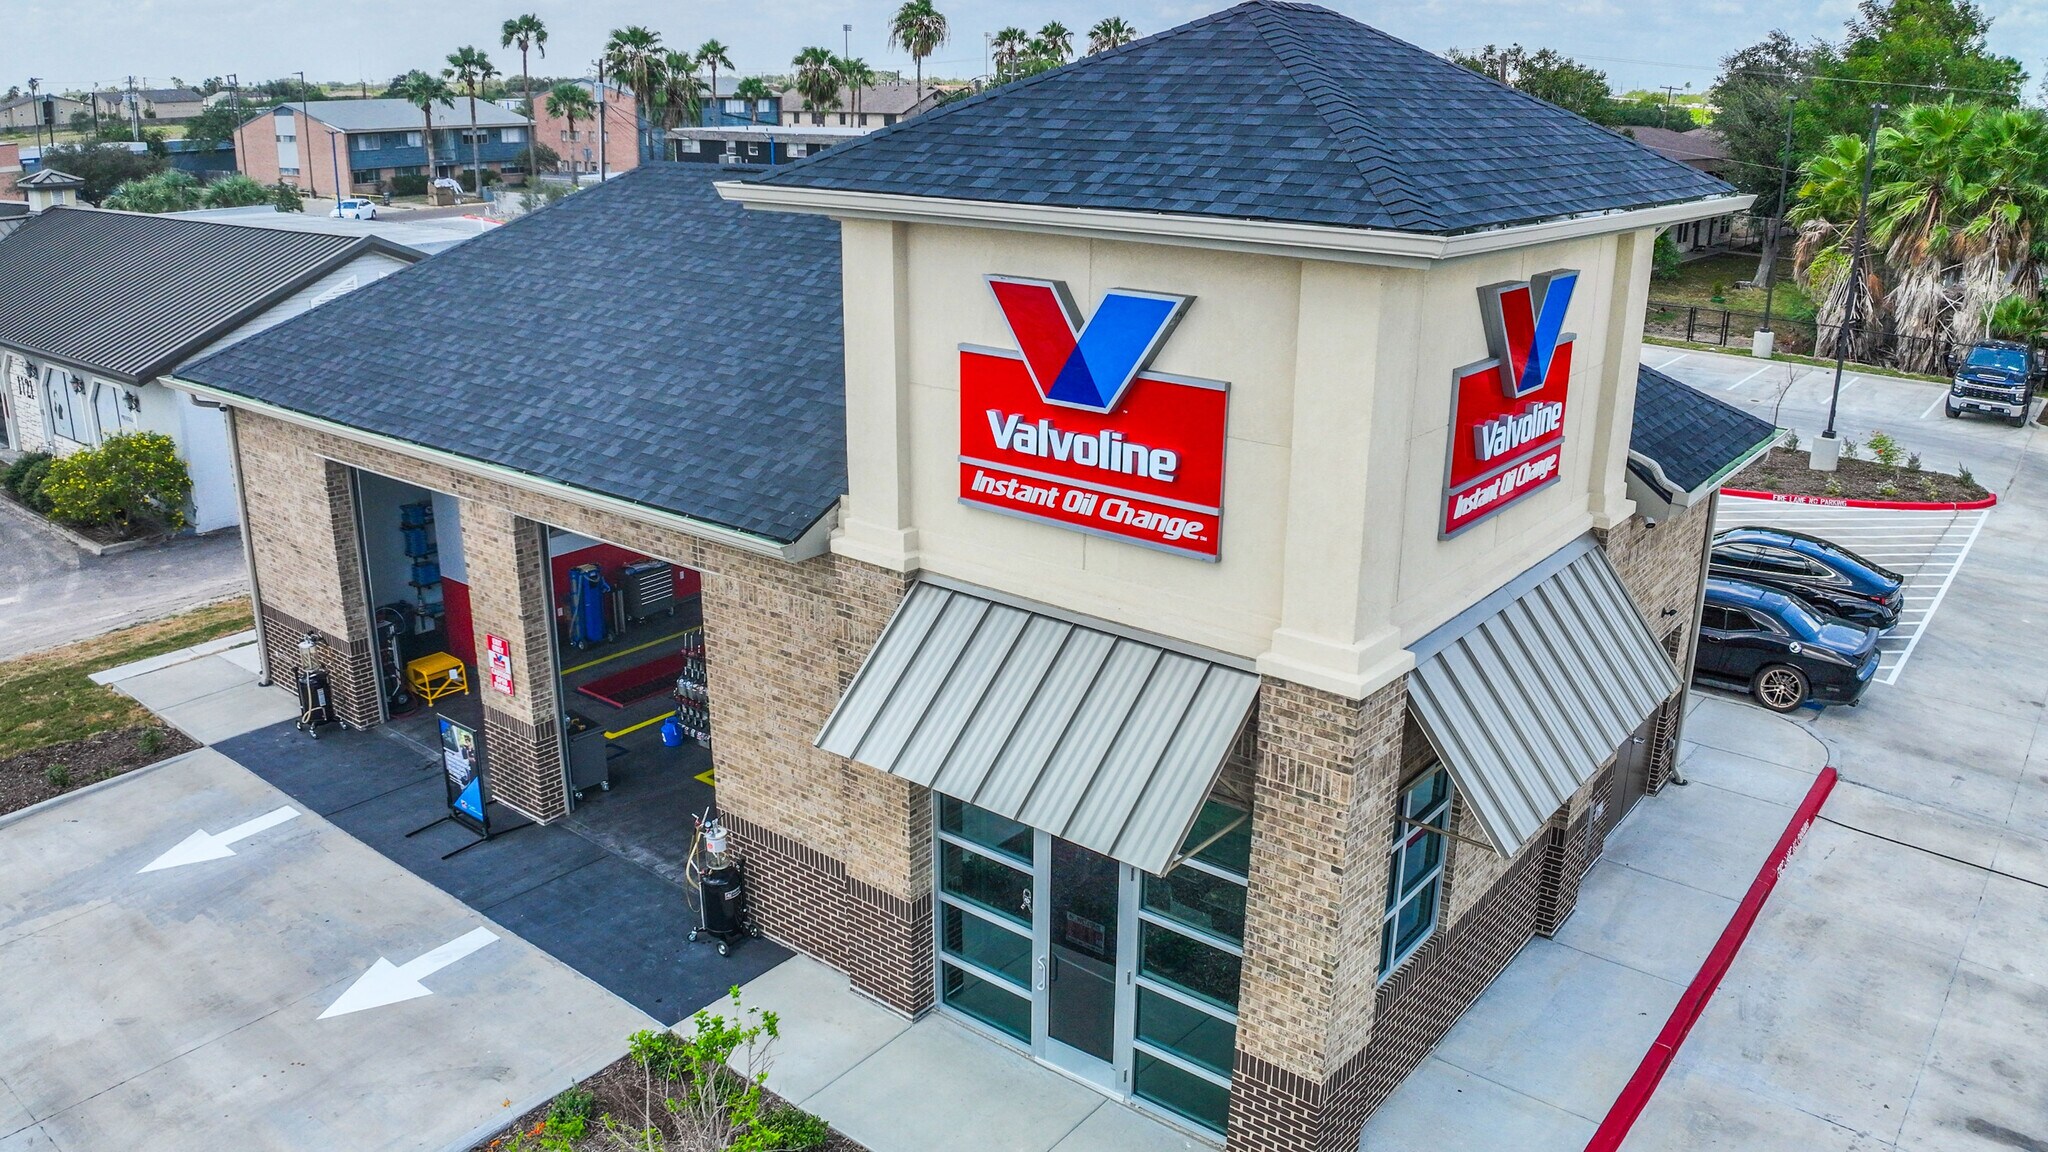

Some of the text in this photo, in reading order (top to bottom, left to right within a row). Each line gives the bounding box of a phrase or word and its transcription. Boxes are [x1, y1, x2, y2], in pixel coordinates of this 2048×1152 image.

[986, 408, 1178, 483] Valvoline
[1481, 402, 1562, 461] Valvoline
[971, 470, 1060, 509] Instant
[1062, 489, 1097, 517] Oil
[1453, 478, 1501, 520] Instant
[1500, 468, 1518, 496] Oil
[1789, 496, 1806, 504] LANE
[1808, 497, 1819, 505] NO
[1820, 498, 1848, 507] PARKING
